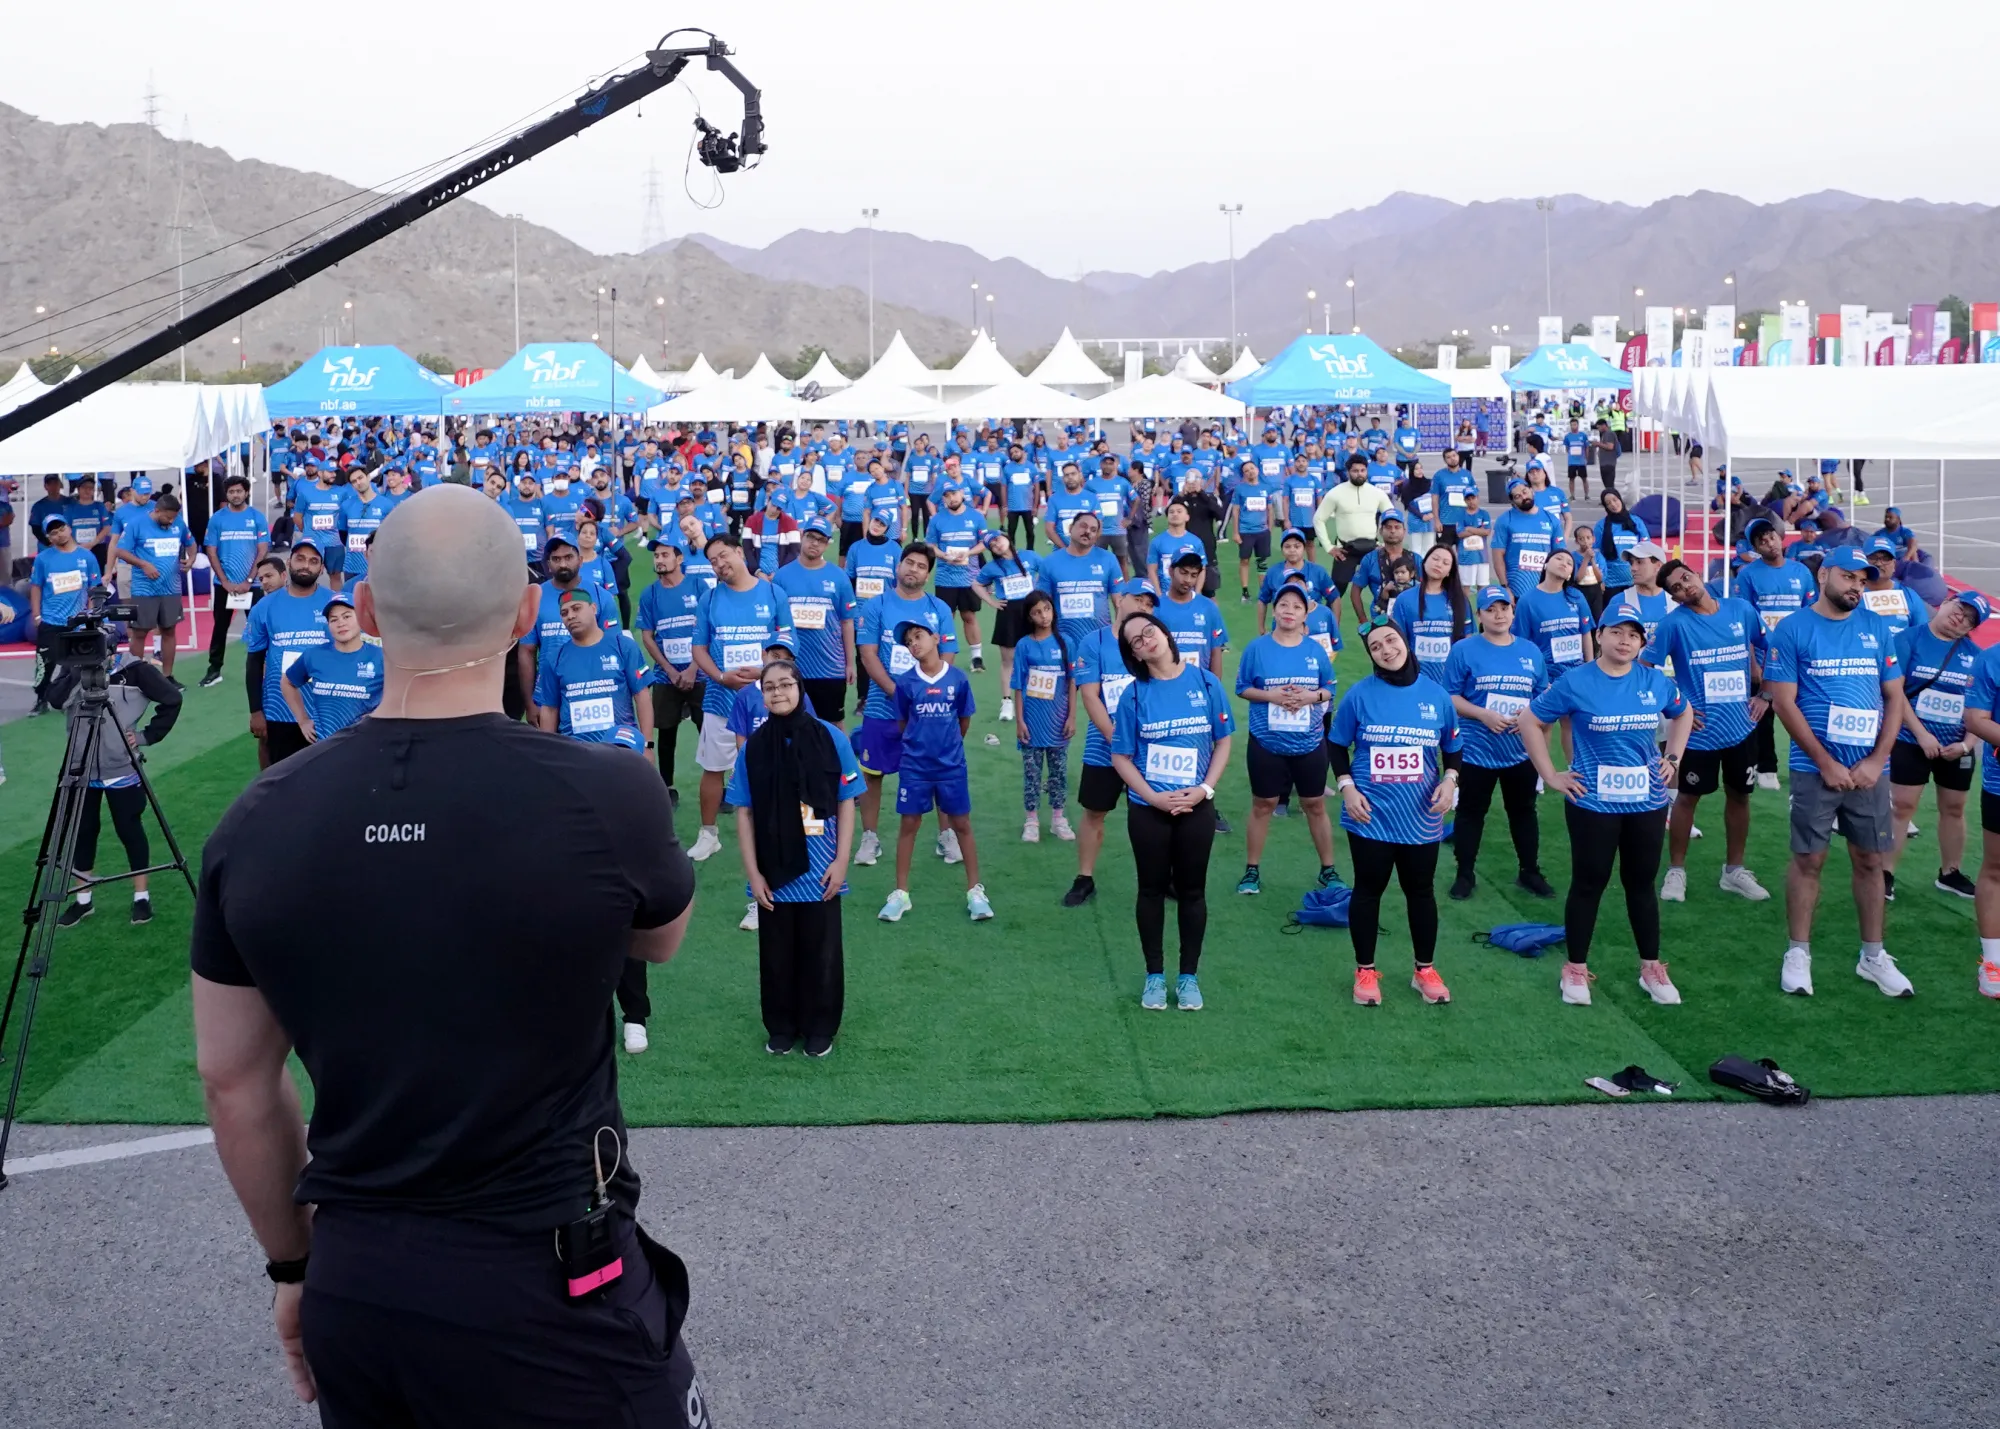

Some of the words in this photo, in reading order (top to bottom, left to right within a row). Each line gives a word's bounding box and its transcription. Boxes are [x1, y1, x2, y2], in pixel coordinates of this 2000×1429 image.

[1324, 353, 1368, 374] nbf
[1558, 356, 1588, 370] nbf
[330, 366, 380, 386] nbf
[532, 360, 586, 382] nbf
[320, 399, 357, 410] nbf.ae
[526, 396, 561, 408] nbf.ae
[1522, 554, 1544, 564] 6162
[859, 580, 881, 591] 3106
[1063, 598, 1091, 609] 4250
[1872, 595, 1899, 607] 296
[793, 609, 823, 620] 3599
[1418, 642, 1448, 654] 4100
[1554, 640, 1580, 652] 4086
[726, 649, 760, 664] 5560
[1030, 676, 1054, 689] 318
[1708, 676, 1743, 692] 4906
[916, 702, 952, 714] SAVVY
[1920, 694, 1961, 713] 4896
[573, 704, 610, 722] 5489
[1592, 715, 1622, 724] START
[1832, 714, 1876, 733] 4897
[1366, 725, 1396, 733] START
[1588, 723, 1618, 732] FINISH
[1362, 733, 1392, 743] FINISH
[1150, 752, 1193, 772] 4102
[1374, 753, 1419, 769] 6153
[1601, 773, 1646, 790] 4900
[365, 823, 426, 843] COACH
